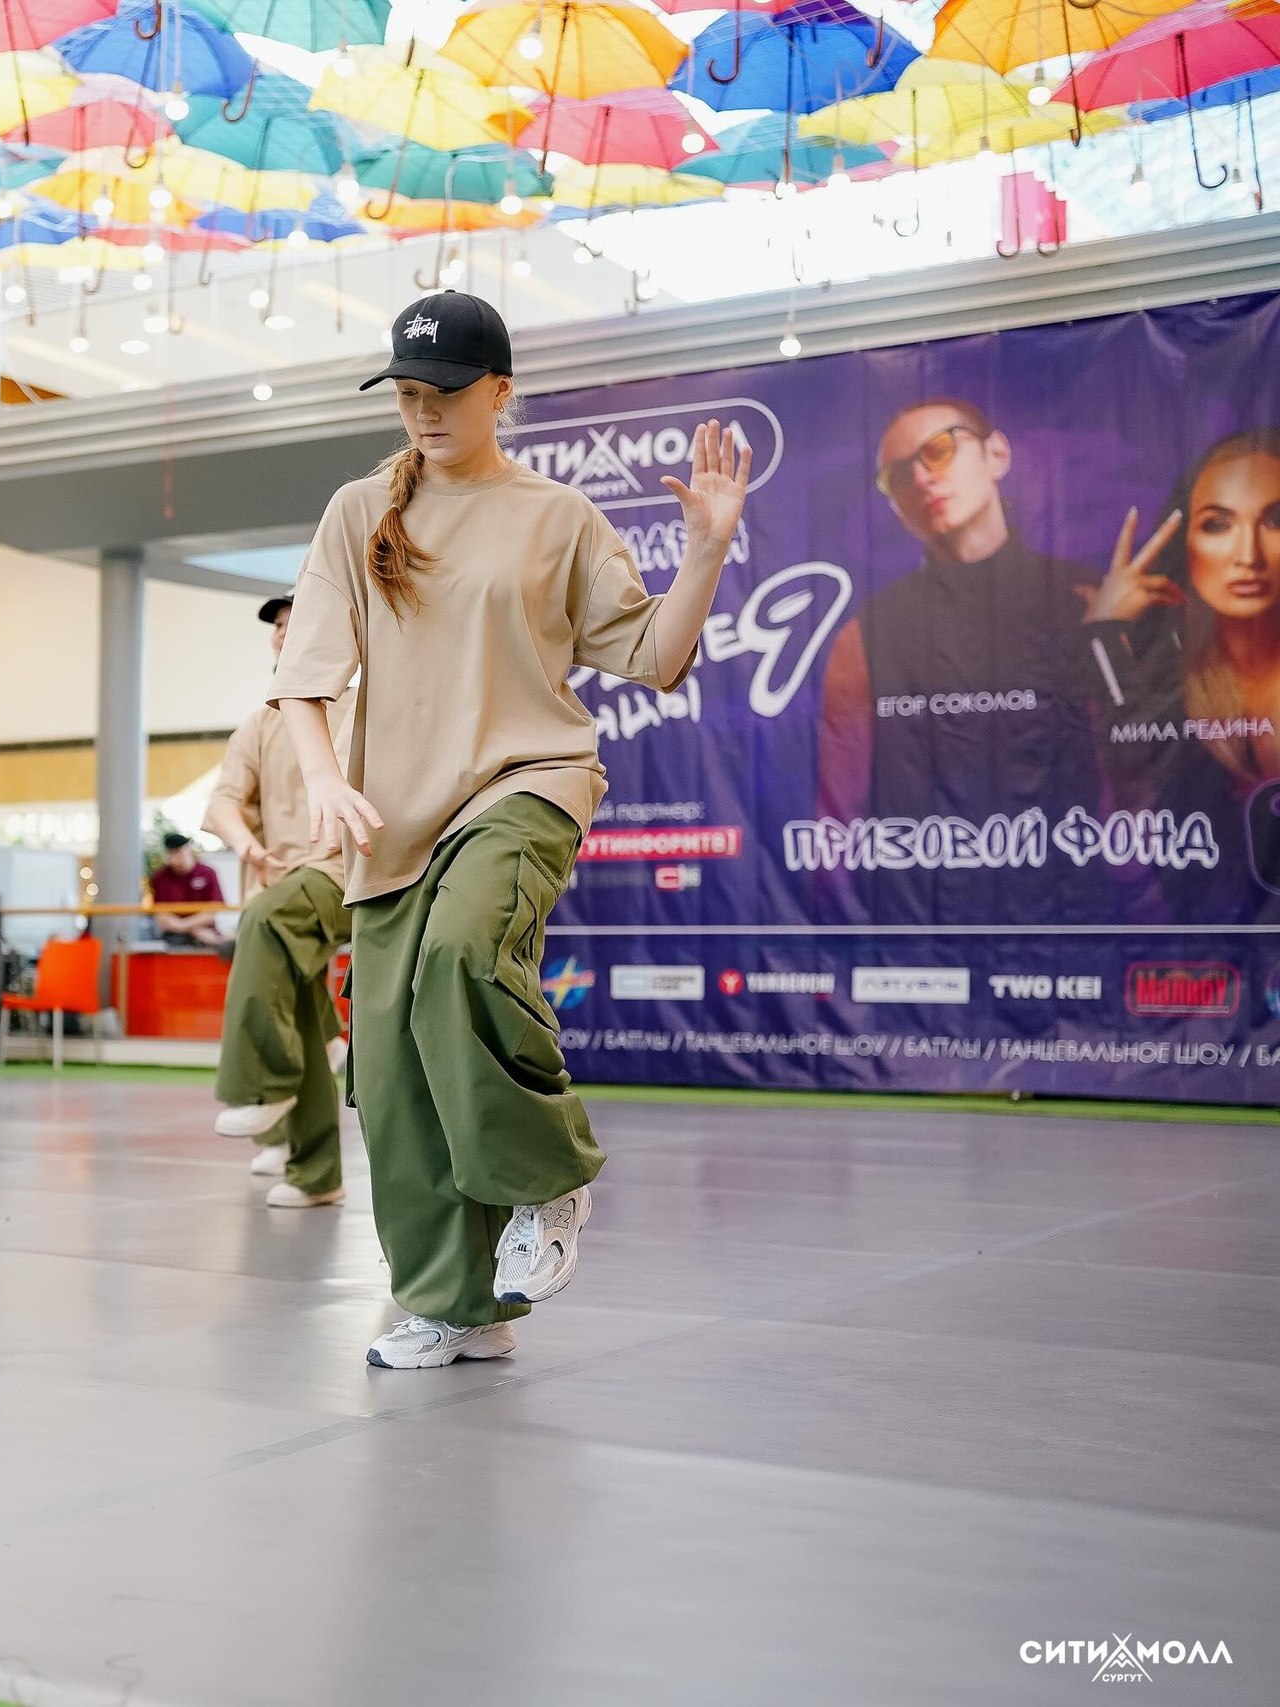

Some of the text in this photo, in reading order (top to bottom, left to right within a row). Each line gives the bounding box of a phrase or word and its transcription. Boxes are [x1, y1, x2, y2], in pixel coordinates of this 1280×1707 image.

[877, 689, 1036, 717] ЕГОР СОКОЛОВ
[1110, 716, 1274, 744] МИЛА РЕДИНА
[782, 805, 1220, 871] ПРИЗОВОЙ ФОНД
[988, 974, 1102, 1000] TWO KEI
[834, 1034, 887, 1057] ШОУ
[999, 1037, 1170, 1064] ТАНЦЕВАЛЬНОЕ
[1175, 1042, 1234, 1067] ШОУ
